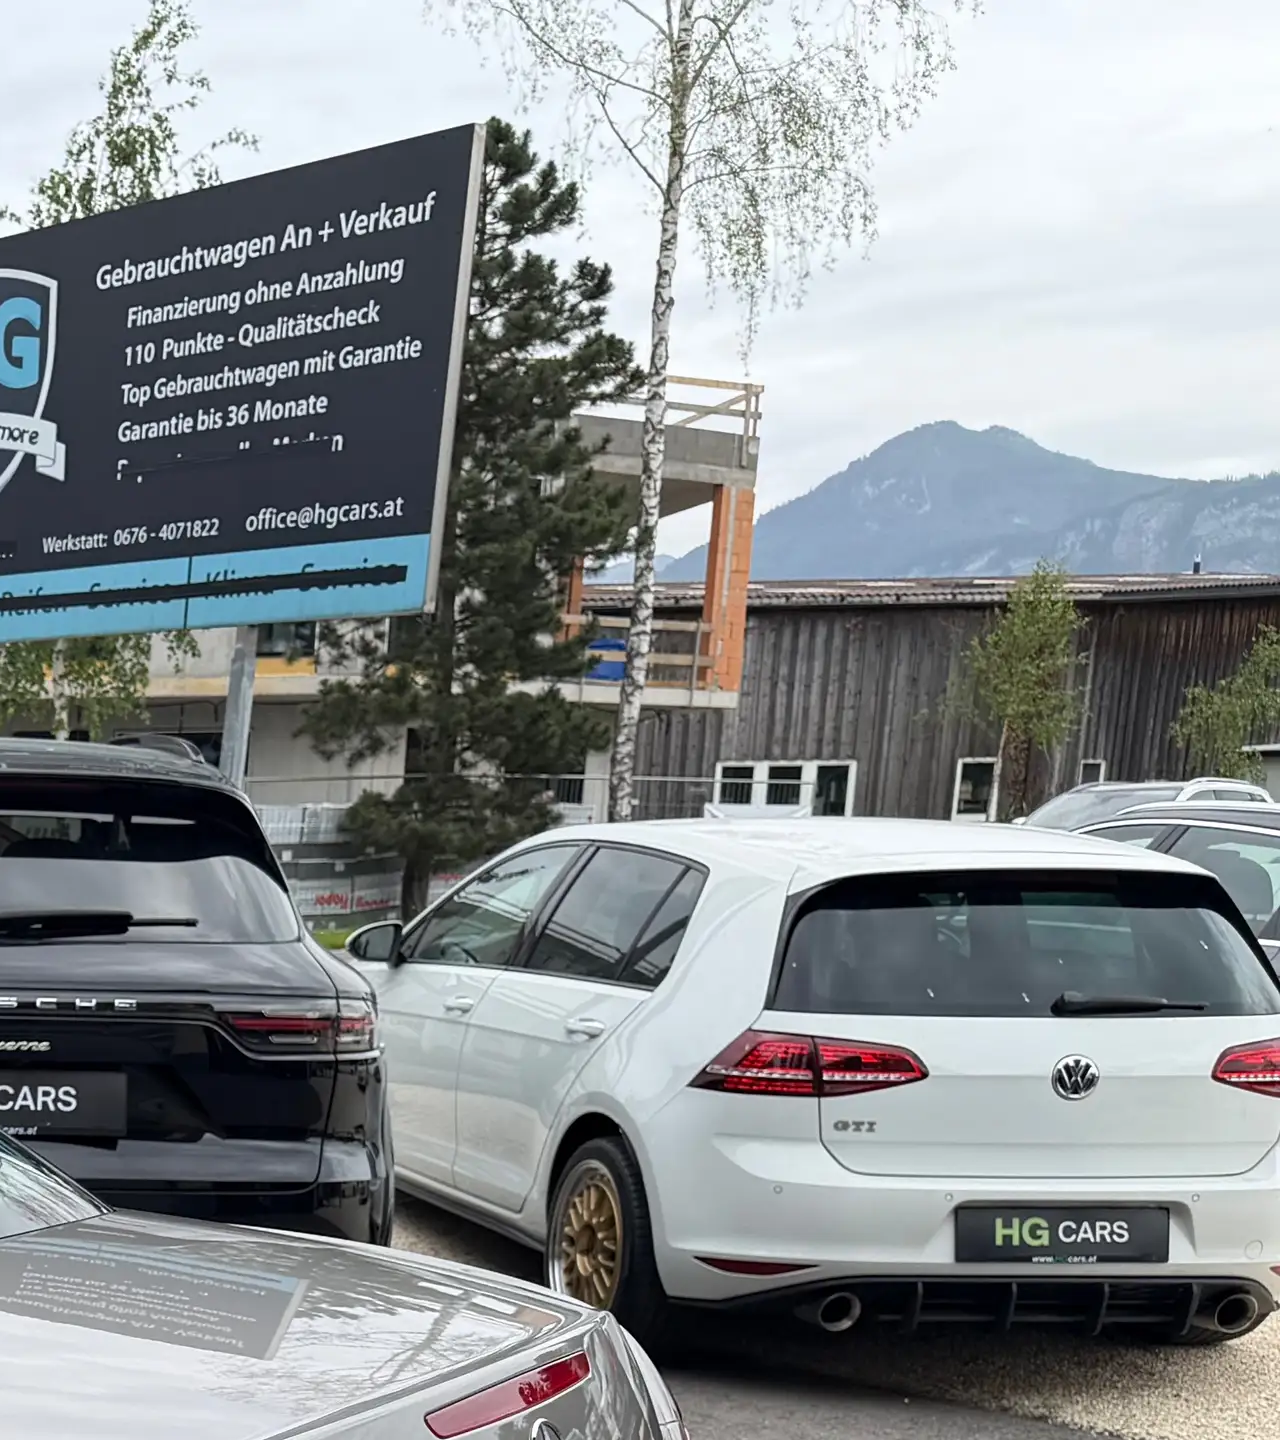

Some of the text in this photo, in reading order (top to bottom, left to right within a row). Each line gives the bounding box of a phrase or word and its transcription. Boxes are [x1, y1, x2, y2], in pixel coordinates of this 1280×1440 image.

[96, 191, 437, 290] Gebrauchtwagen An + Verkauf
[127, 257, 405, 328] Finanzierung ohne Anzahlung
[125, 343, 156, 366] 110
[162, 331, 225, 360] Punkte
[238, 299, 381, 347] Qualitätscheck
[121, 335, 423, 407] Top Gebrauchtwagen mit Garantie
[117, 395, 329, 443] Garantie bis 36 Monate
[42, 533, 108, 554] Werkstatt:
[113, 528, 148, 547] 0676
[159, 518, 219, 544] 4071822
[245, 496, 405, 531] office@hgcars.at
[833, 1120, 877, 1132] GTI
[995, 1217, 1130, 1247] HG CARS
